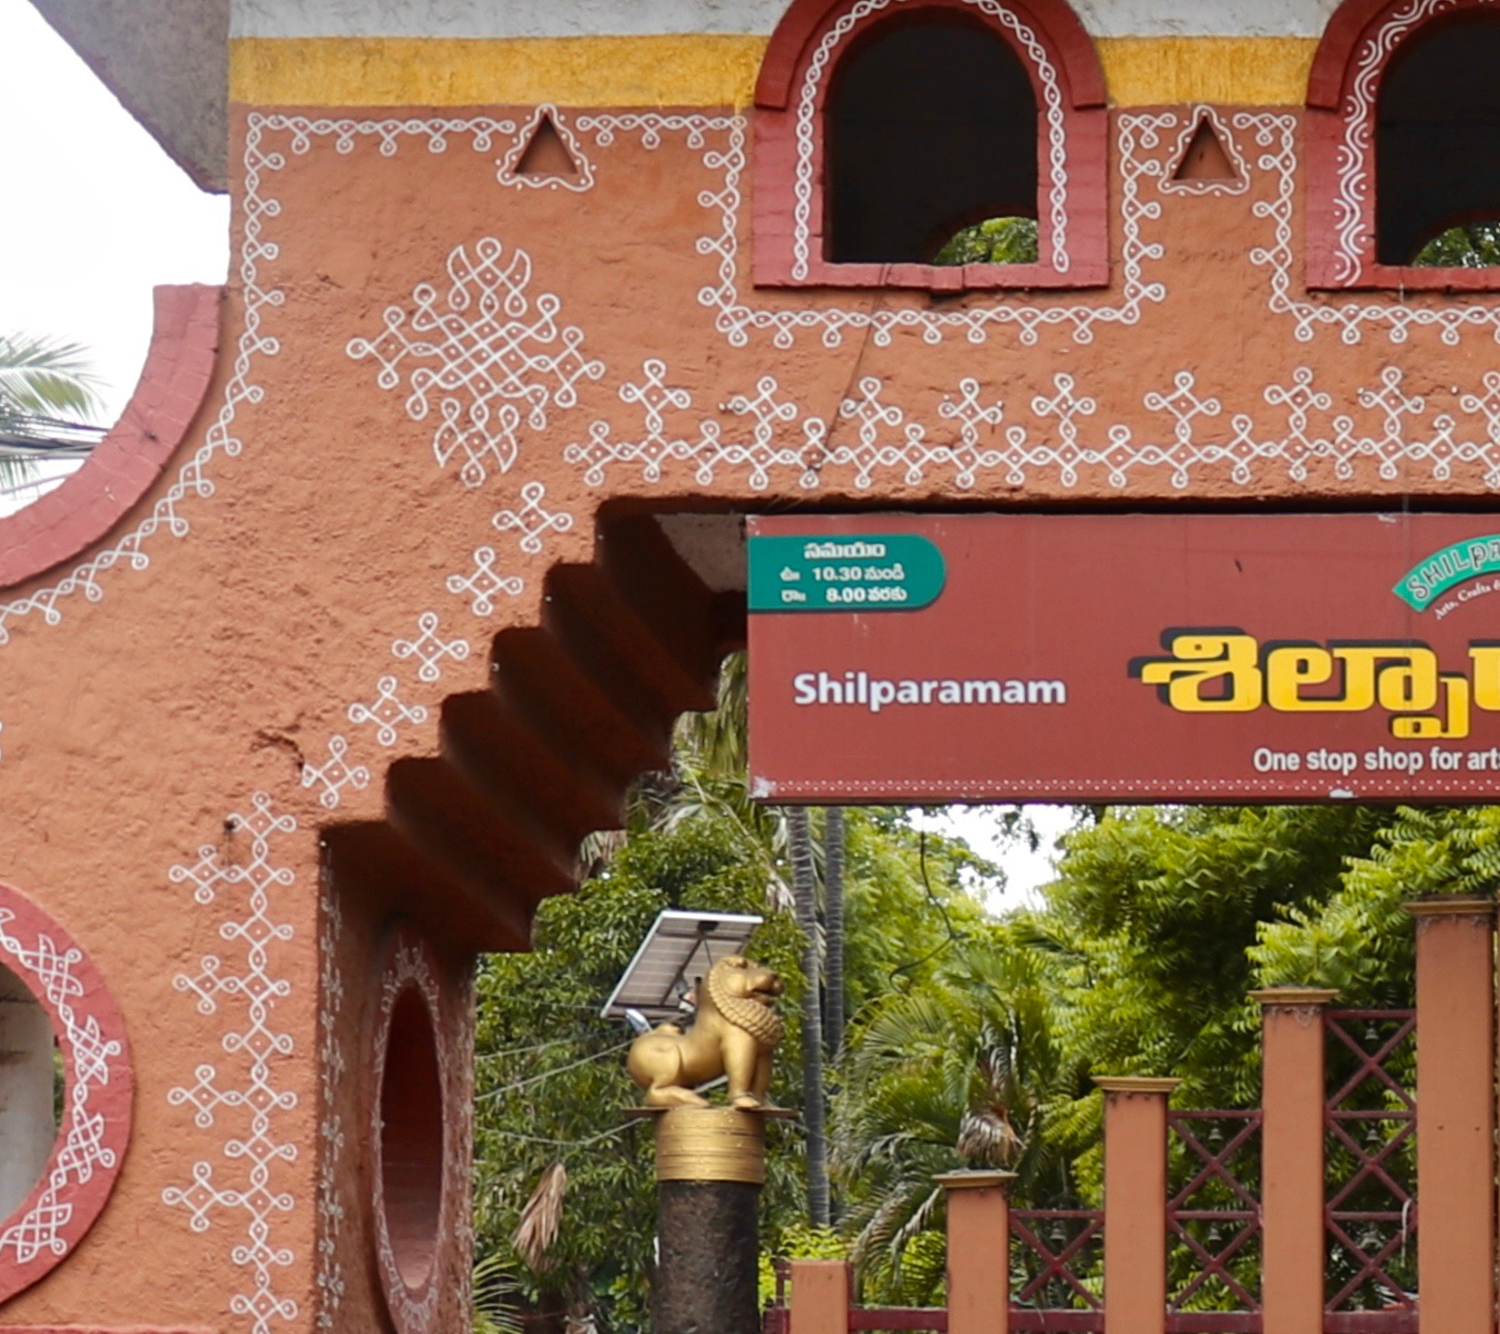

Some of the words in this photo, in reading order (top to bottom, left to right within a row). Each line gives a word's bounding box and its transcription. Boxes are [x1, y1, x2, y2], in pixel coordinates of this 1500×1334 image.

[813, 566, 862, 581] 10.30
[826, 587, 866, 603] 8.00
[1457, 582, 1491, 603] Crafts
[793, 671, 1067, 712] Shilparamam
[1253, 747, 1301, 772] One
[1306, 748, 1358, 776] stop
[1364, 746, 1424, 776] shop
[1430, 746, 1463, 770] for
